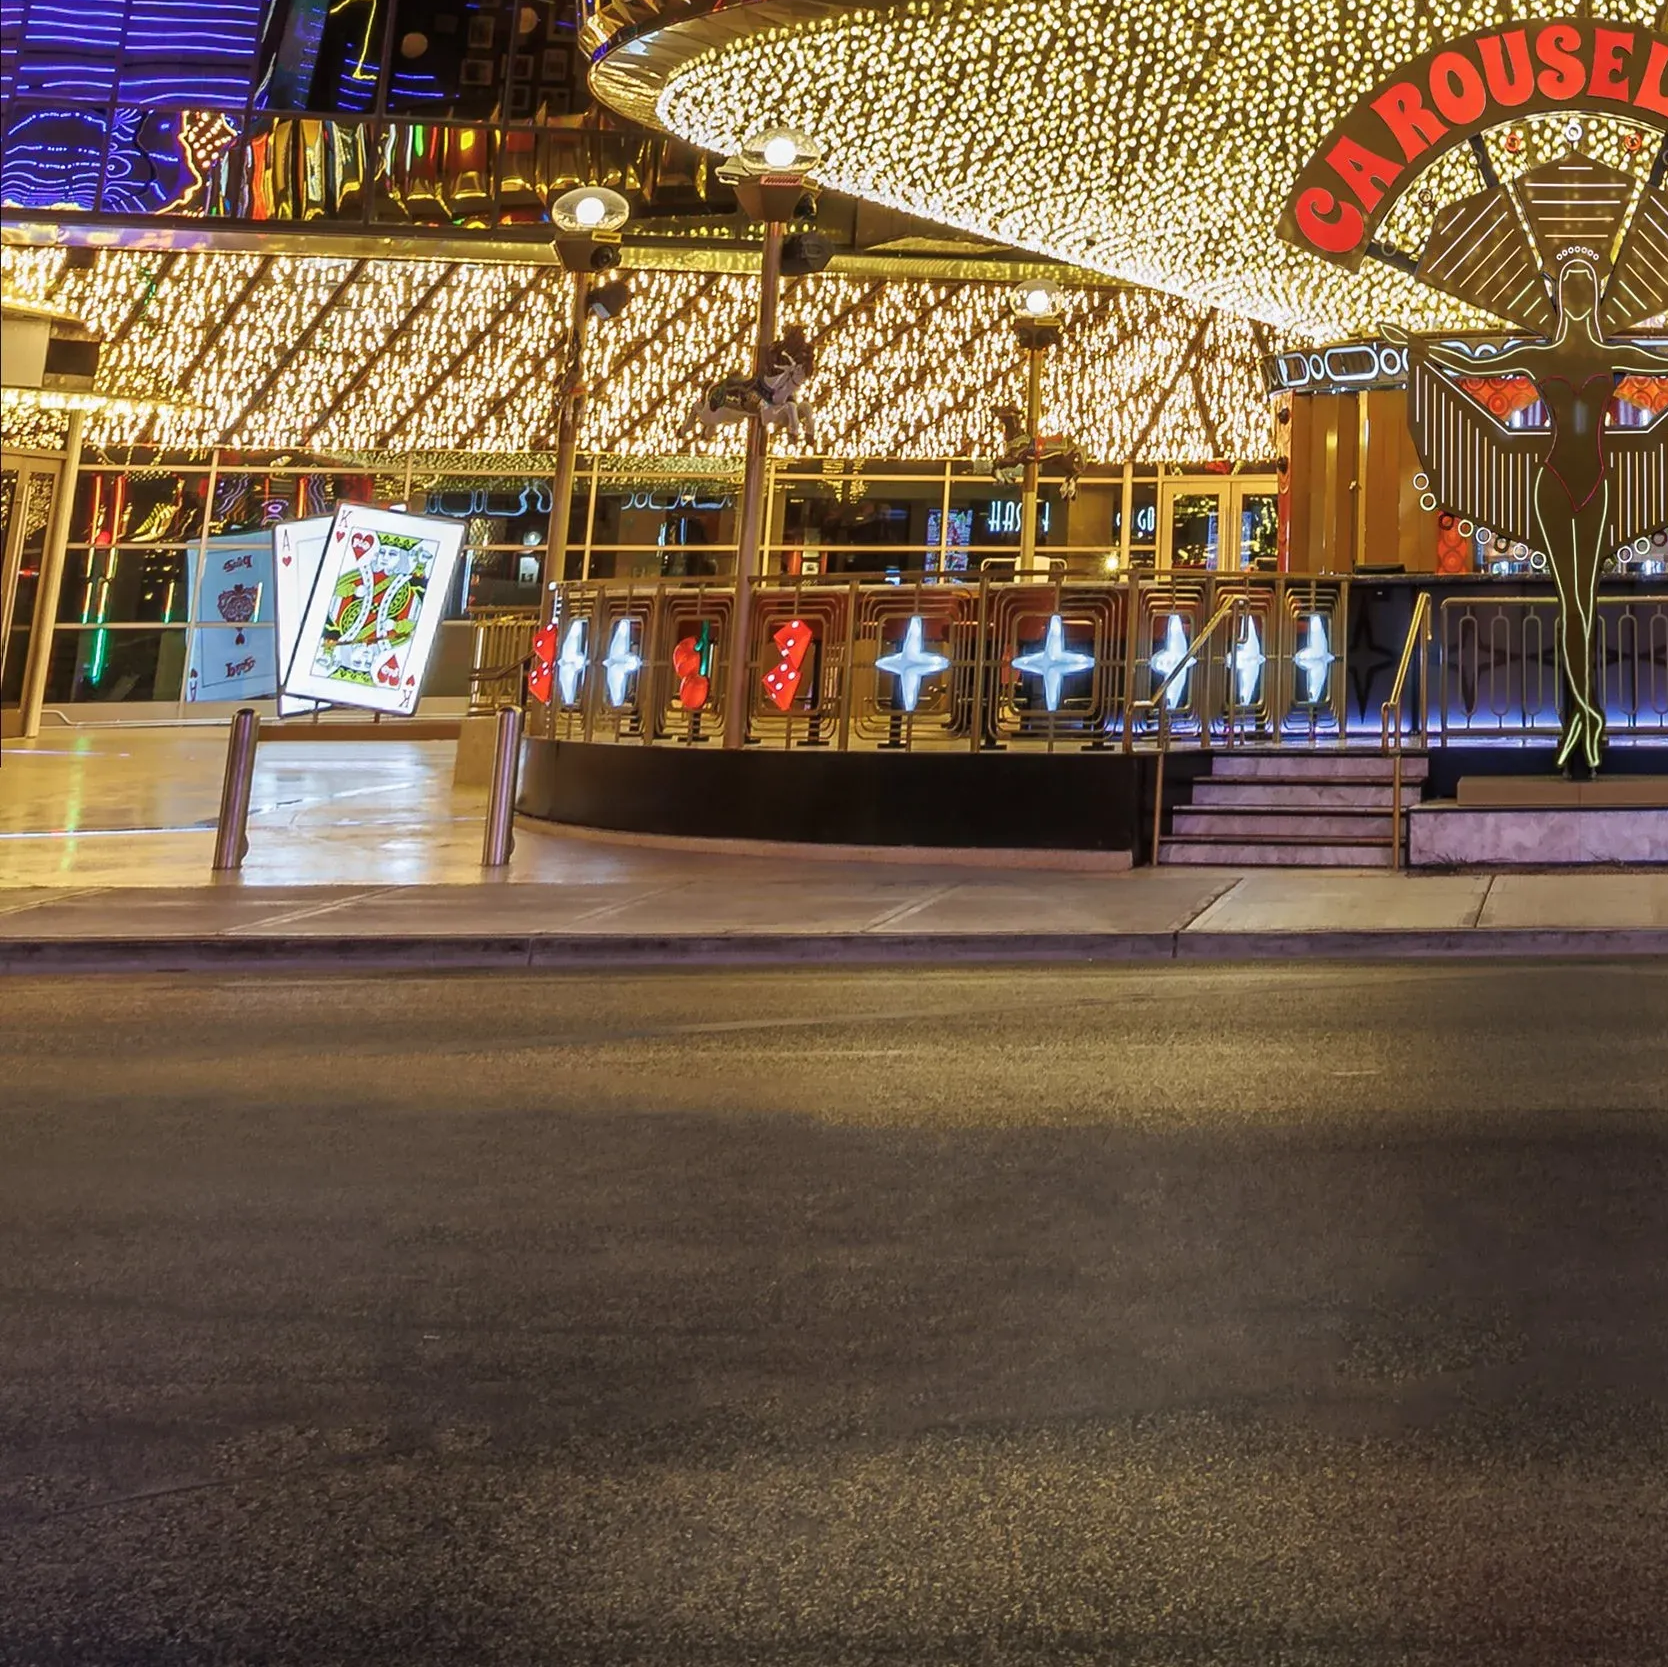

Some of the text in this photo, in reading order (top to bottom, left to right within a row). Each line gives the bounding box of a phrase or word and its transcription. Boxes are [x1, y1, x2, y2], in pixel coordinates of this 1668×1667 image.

[338, 510, 353, 528] K
[282, 528, 291, 552] A
[399, 689, 413, 708] K
